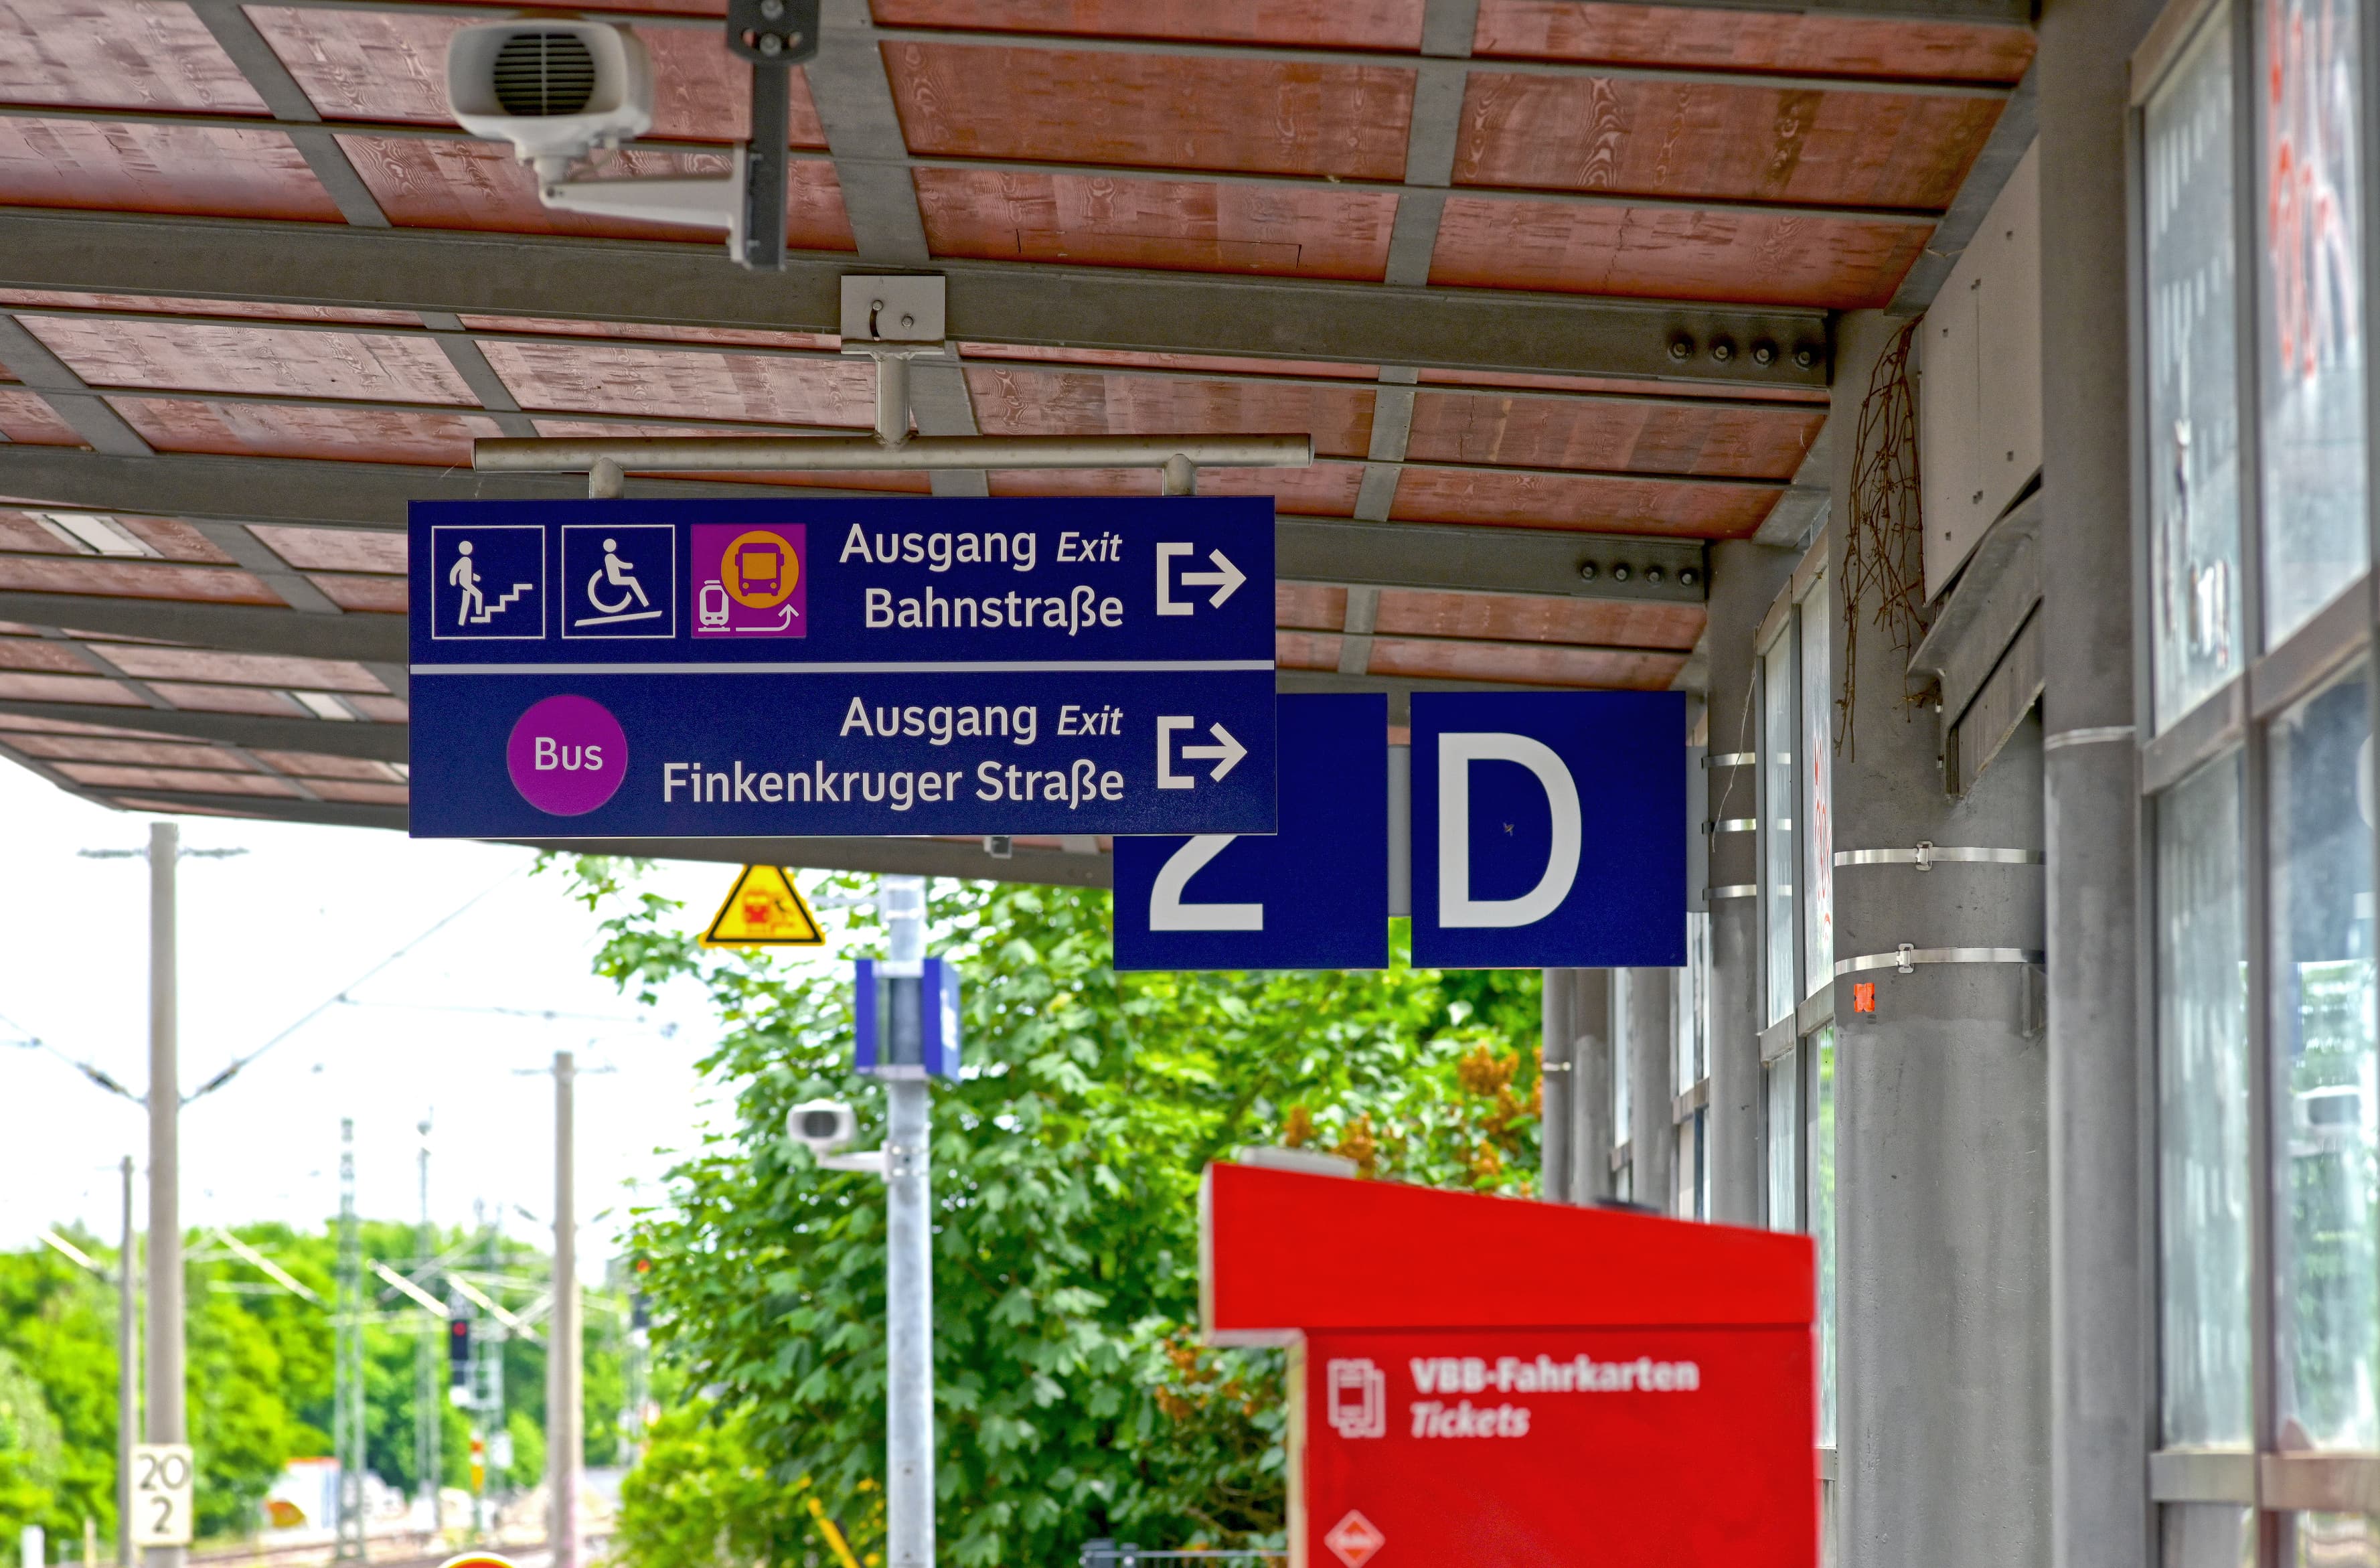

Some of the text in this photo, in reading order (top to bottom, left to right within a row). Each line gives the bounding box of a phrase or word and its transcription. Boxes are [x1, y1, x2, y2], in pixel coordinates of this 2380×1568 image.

[839, 522, 1123, 573] Ausgang Exit
[865, 584, 1124, 637] Bahnstraße
[840, 696, 1124, 747] Ausgang Exit
[534, 736, 604, 771] Bus
[663, 758, 1125, 812] Finkenkruger Straße
[1437, 732, 1583, 929] D
[1410, 1354, 1700, 1394] VBB-Fahrkarten
[1411, 1400, 1530, 1438] Tickets
[137, 1452, 191, 1491] 20
[150, 1494, 173, 1535] 2
